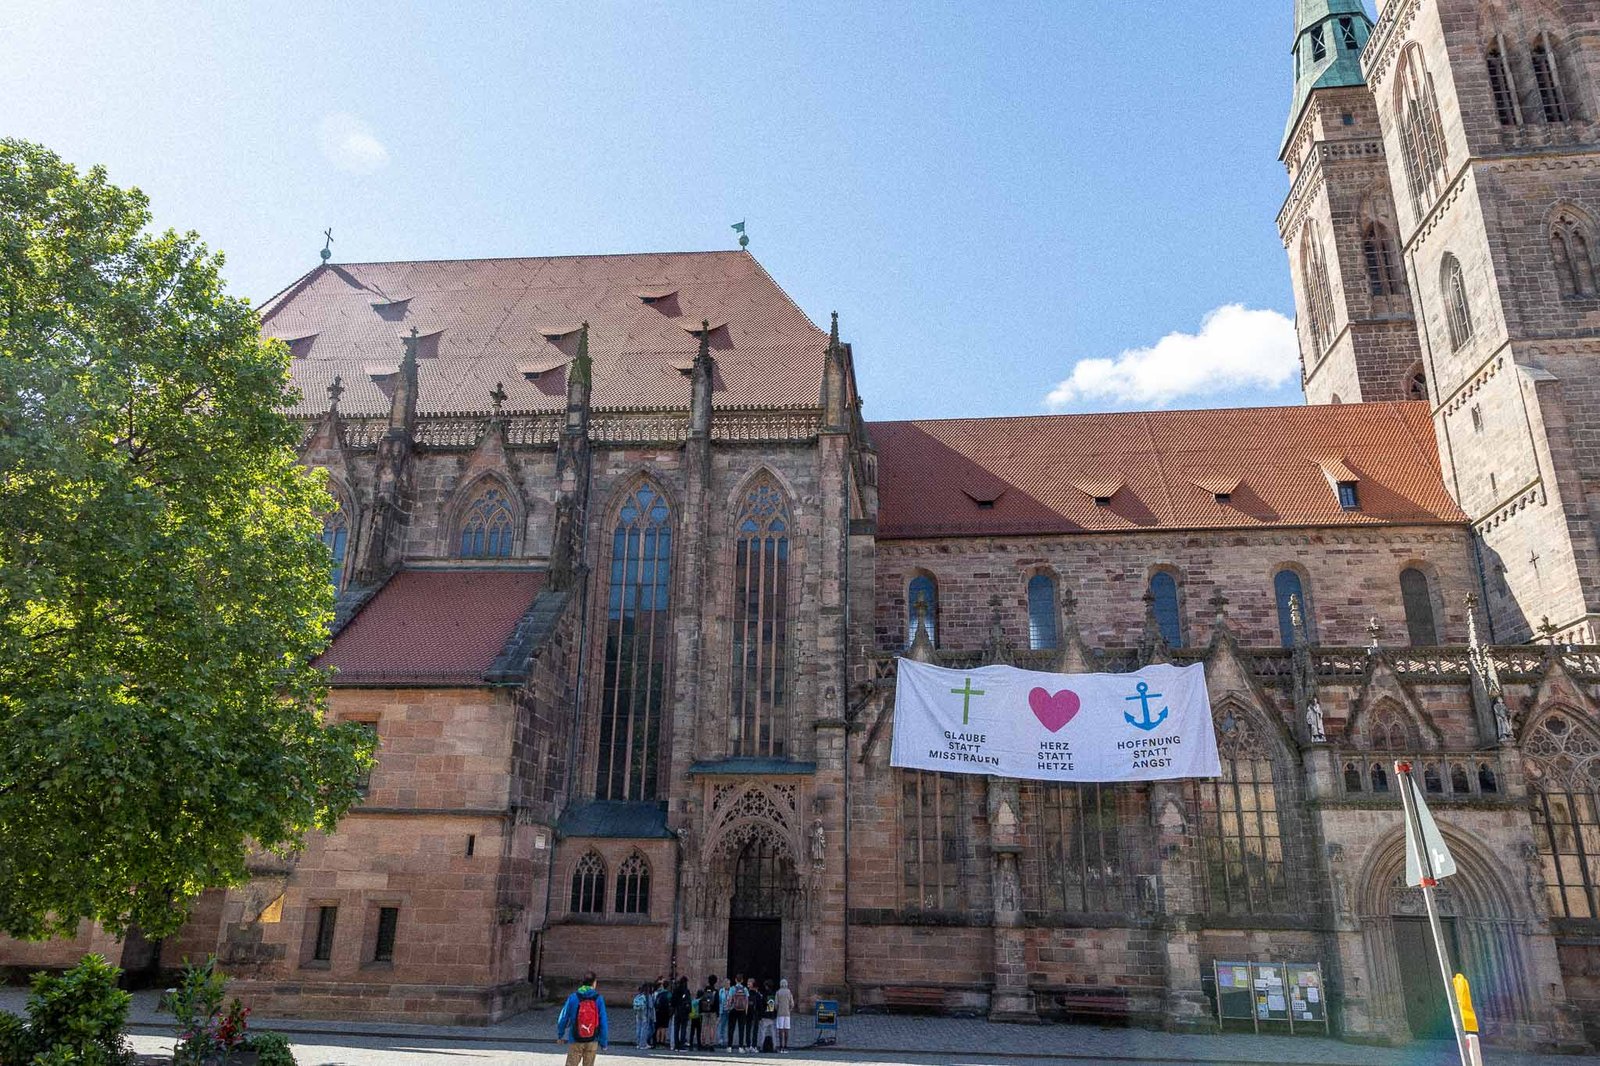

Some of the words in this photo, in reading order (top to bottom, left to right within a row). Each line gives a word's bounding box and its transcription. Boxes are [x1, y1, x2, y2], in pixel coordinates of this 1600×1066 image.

[943, 730, 986, 744] GLAUBE
[1117, 735, 1181, 750] HOFFNUNG
[948, 741, 981, 754] STATT
[1040, 741, 1070, 751] HERZ
[928, 749, 1000, 766] MISSTRAUEN
[1037, 751, 1073, 761] STATT
[1133, 747, 1168, 759] STATT
[1037, 761, 1074, 771] HETZE
[1132, 758, 1172, 769] ANGST
